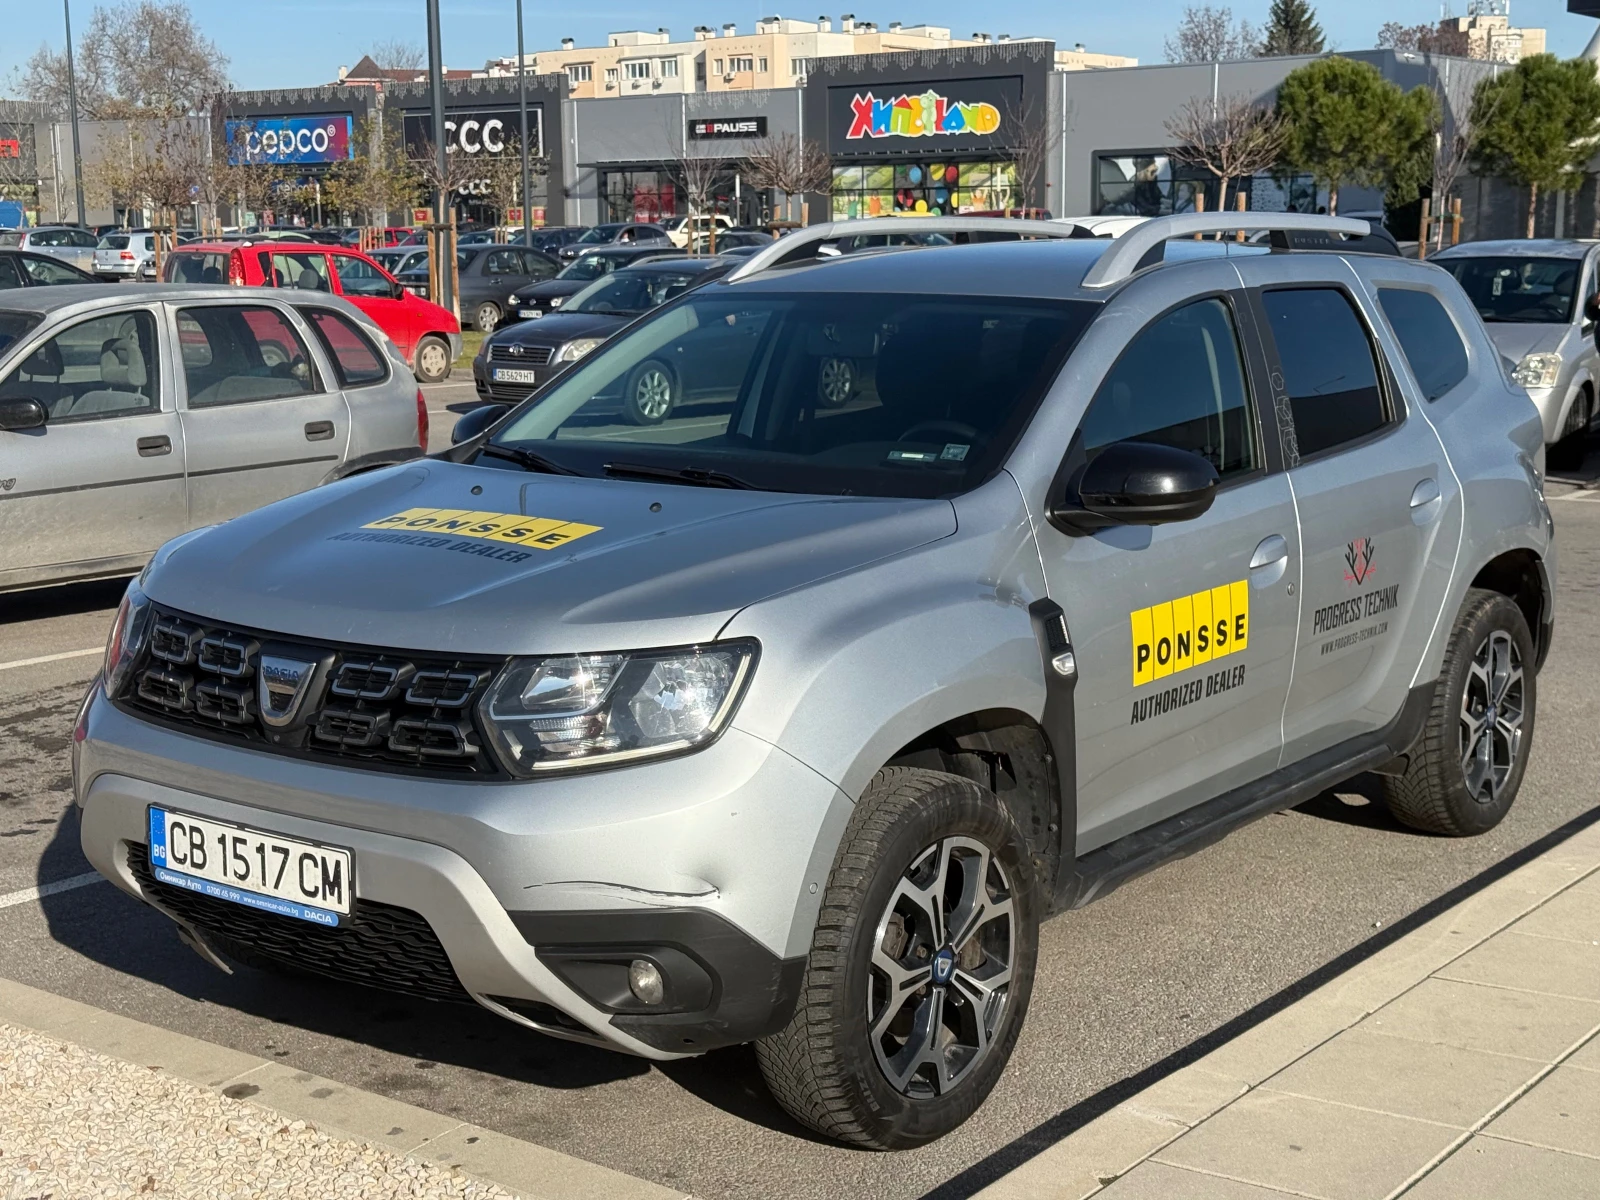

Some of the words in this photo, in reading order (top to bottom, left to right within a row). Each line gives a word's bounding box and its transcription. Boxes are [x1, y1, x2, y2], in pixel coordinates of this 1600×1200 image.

[713, 121, 758, 133] PAUSE
[245, 128, 328, 160] pepco
[507, 371, 523, 381] 5629
[524, 372, 532, 381] HT
[374, 516, 570, 545] PONSSE
[326, 531, 448, 549] AUTHORIZED
[448, 540, 533, 564] DEALER
[1313, 596, 1362, 636] PROGRESS
[1364, 584, 1400, 618] TECHNIK
[1137, 613, 1246, 673] PONSSE
[1321, 621, 1389, 656] WWW.PROGRESS-TECHNIK.COM
[265, 665, 299, 679] DACIA
[1130, 678, 1203, 726] AUTHORIZED
[1205, 664, 1246, 698] DEALER
[153, 843, 165, 858] BG
[170, 821, 207, 870] CB
[217, 833, 291, 891] 1517
[298, 852, 344, 905] CM
[160, 871, 187, 887] Омникар
[187, 879, 202, 891] Ауто
[206, 885, 221, 896] 0700
[229, 891, 240, 901] 999
[243, 896, 299, 917] www.omnicar-auto.bg
[304, 909, 333, 924] DACIA
